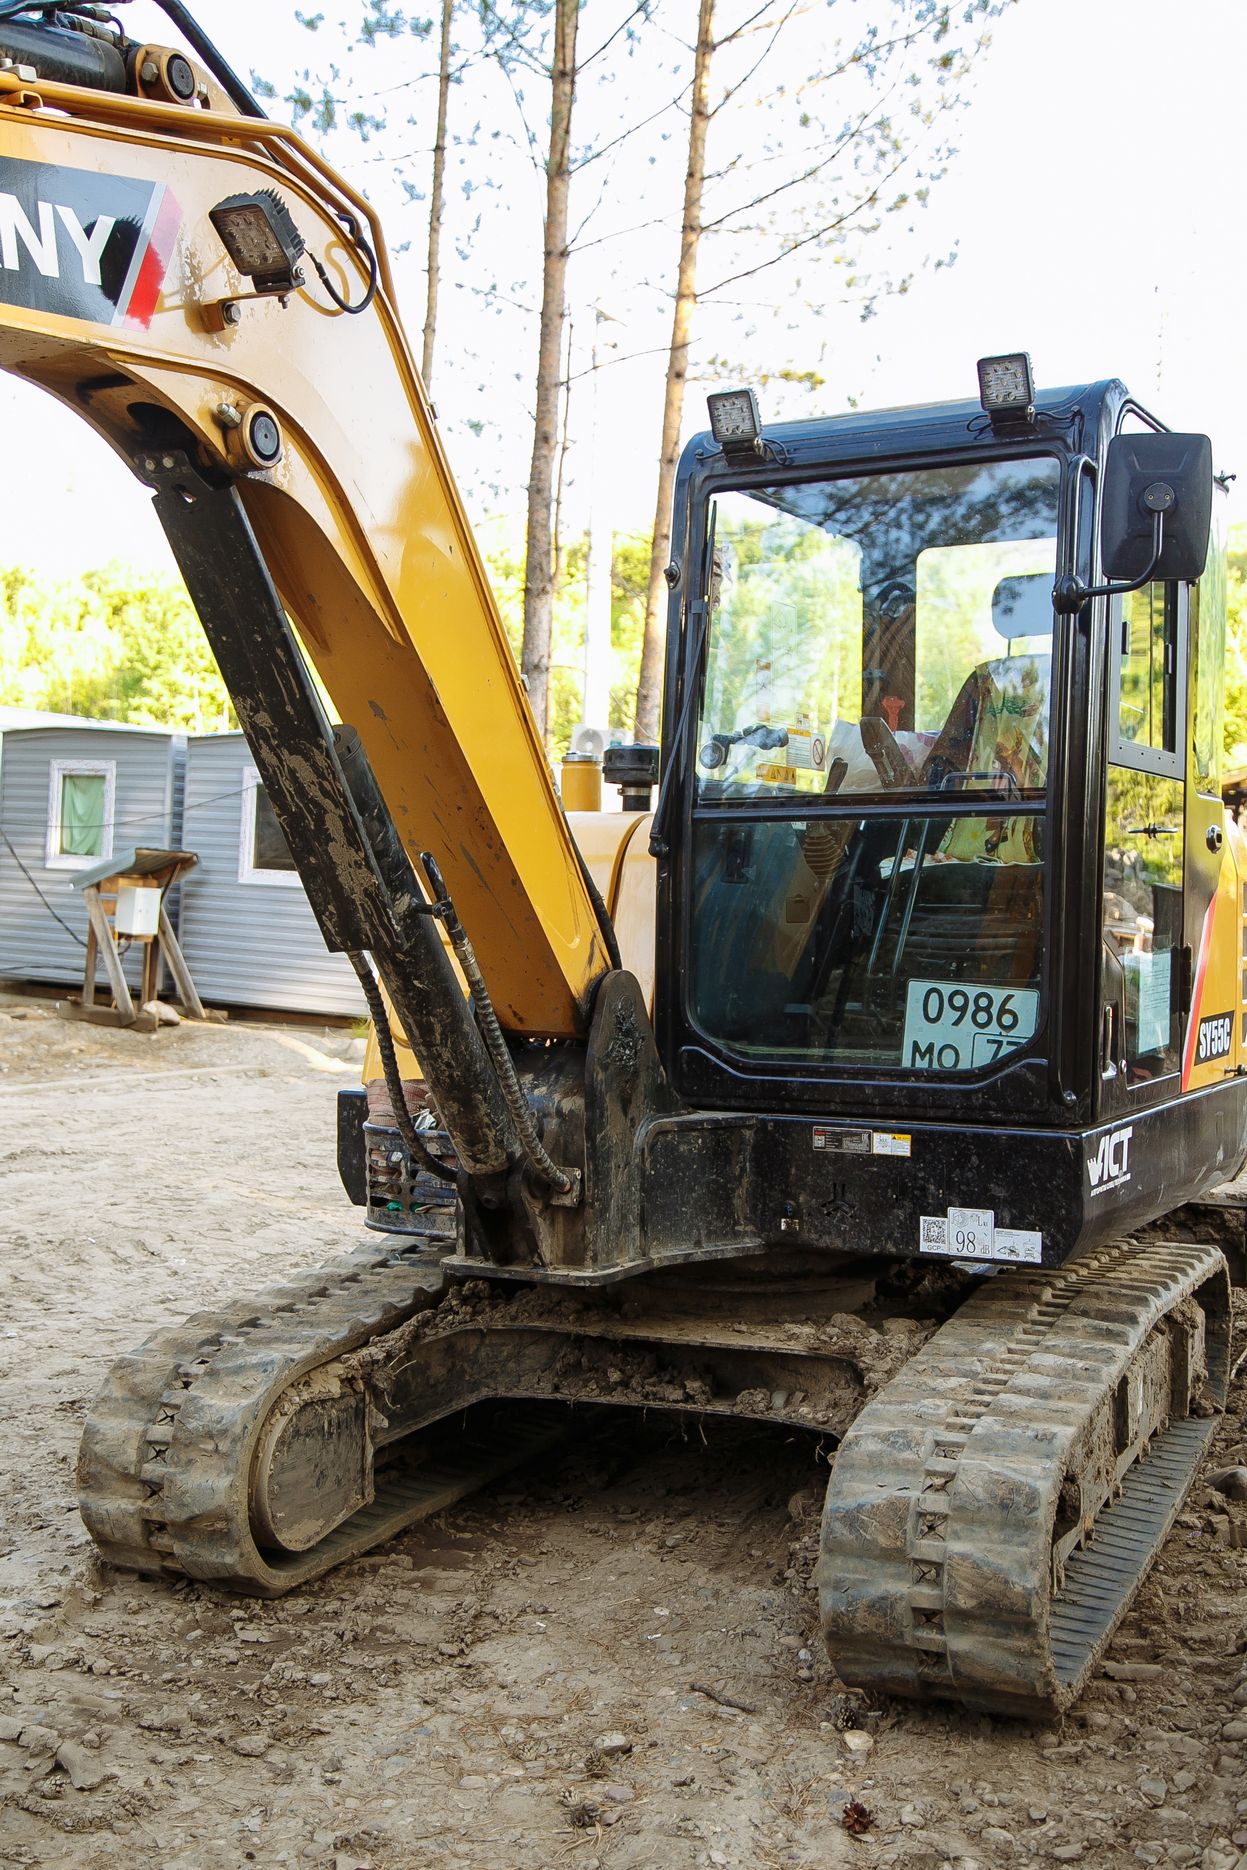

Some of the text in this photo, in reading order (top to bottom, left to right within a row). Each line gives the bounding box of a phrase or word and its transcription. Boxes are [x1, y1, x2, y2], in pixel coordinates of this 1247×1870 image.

[0, 192, 116, 285] NY
[922, 987, 1019, 1033] 0986
[1199, 1017, 1230, 1059] SY55C
[955, 1231, 976, 1253] 98
